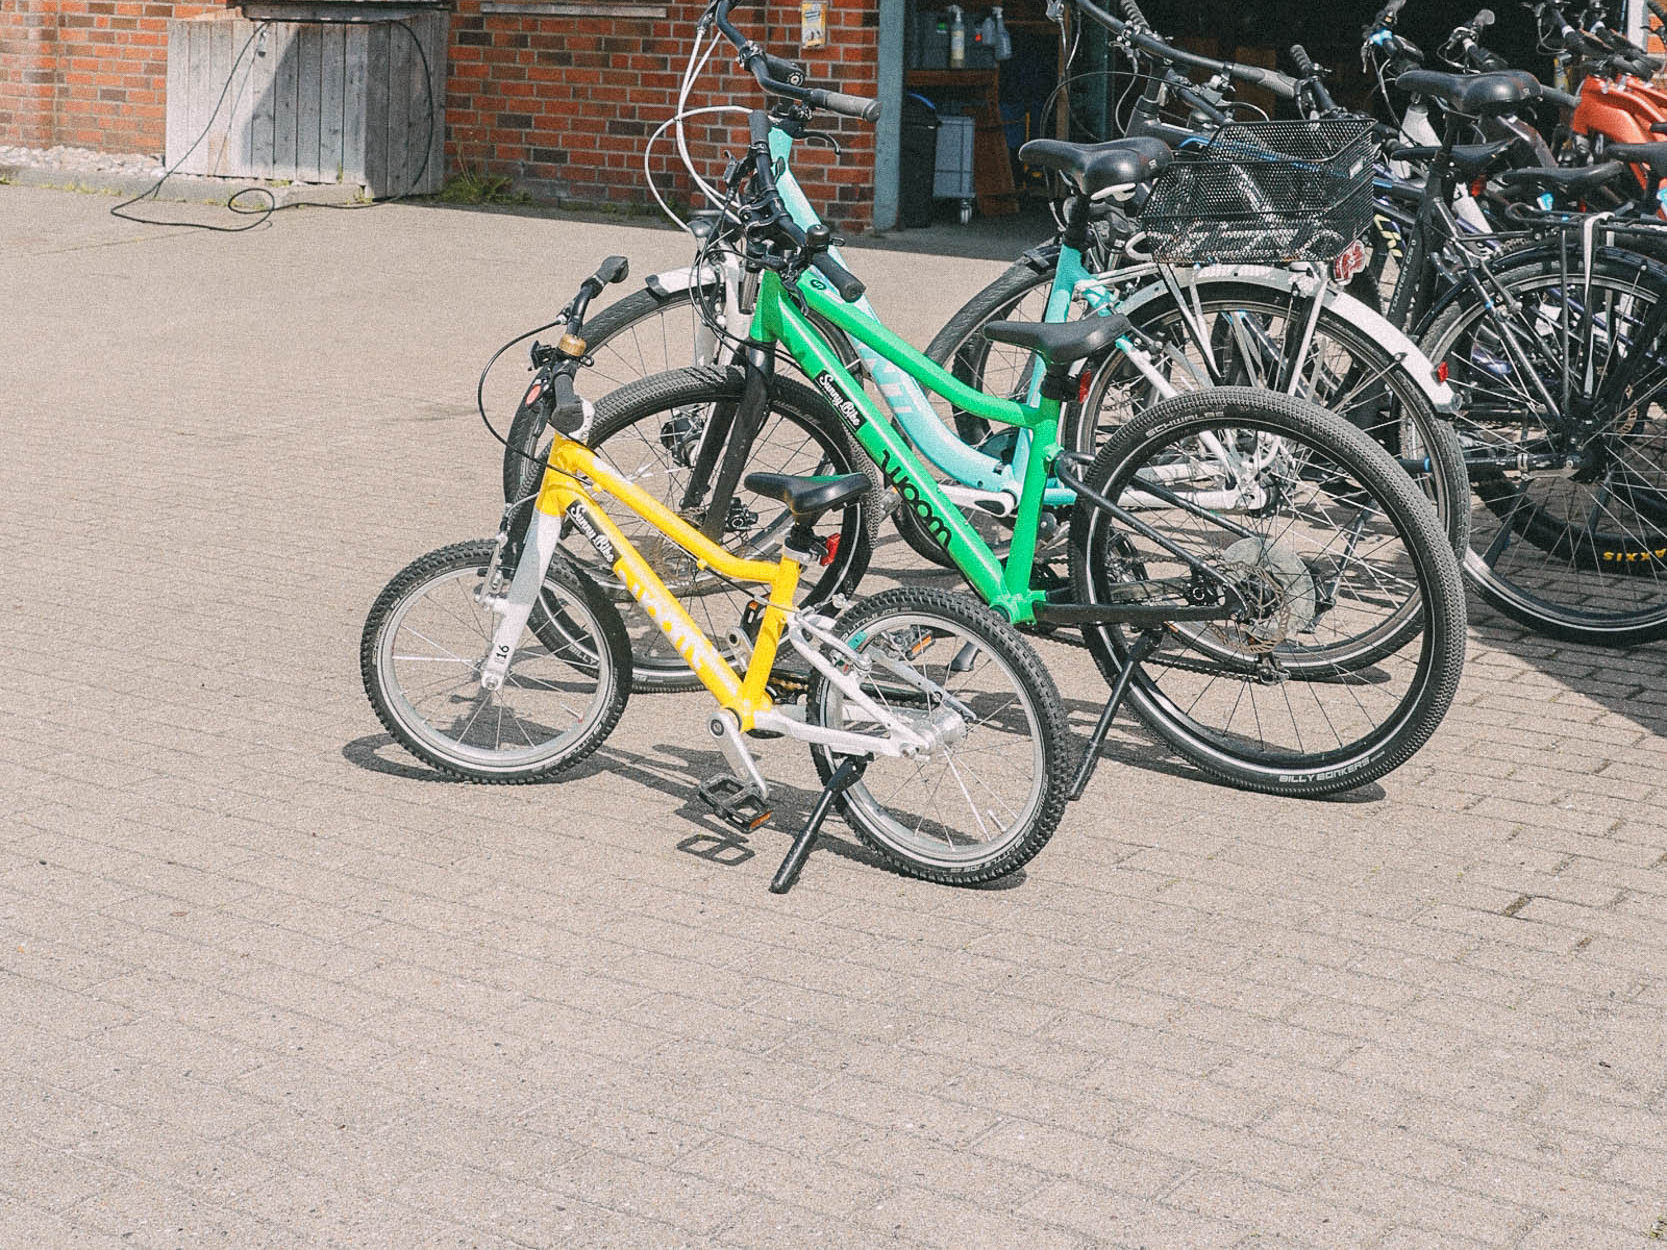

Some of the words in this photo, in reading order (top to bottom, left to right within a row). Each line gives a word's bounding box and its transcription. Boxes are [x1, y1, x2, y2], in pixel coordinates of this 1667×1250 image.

[820, 374, 844, 408] Sunny
[840, 401, 861, 426] Bike
[881, 449, 952, 549] woom
[571, 505, 596, 539] Sunny
[594, 535, 615, 563] Bike
[1602, 547, 1667, 563] AXXIS
[495, 645, 510, 659] 16
[568, 644, 597, 665] BILLY
[1278, 773, 1315, 783] BILLY
[1316, 756, 1370, 781] BONKERS
